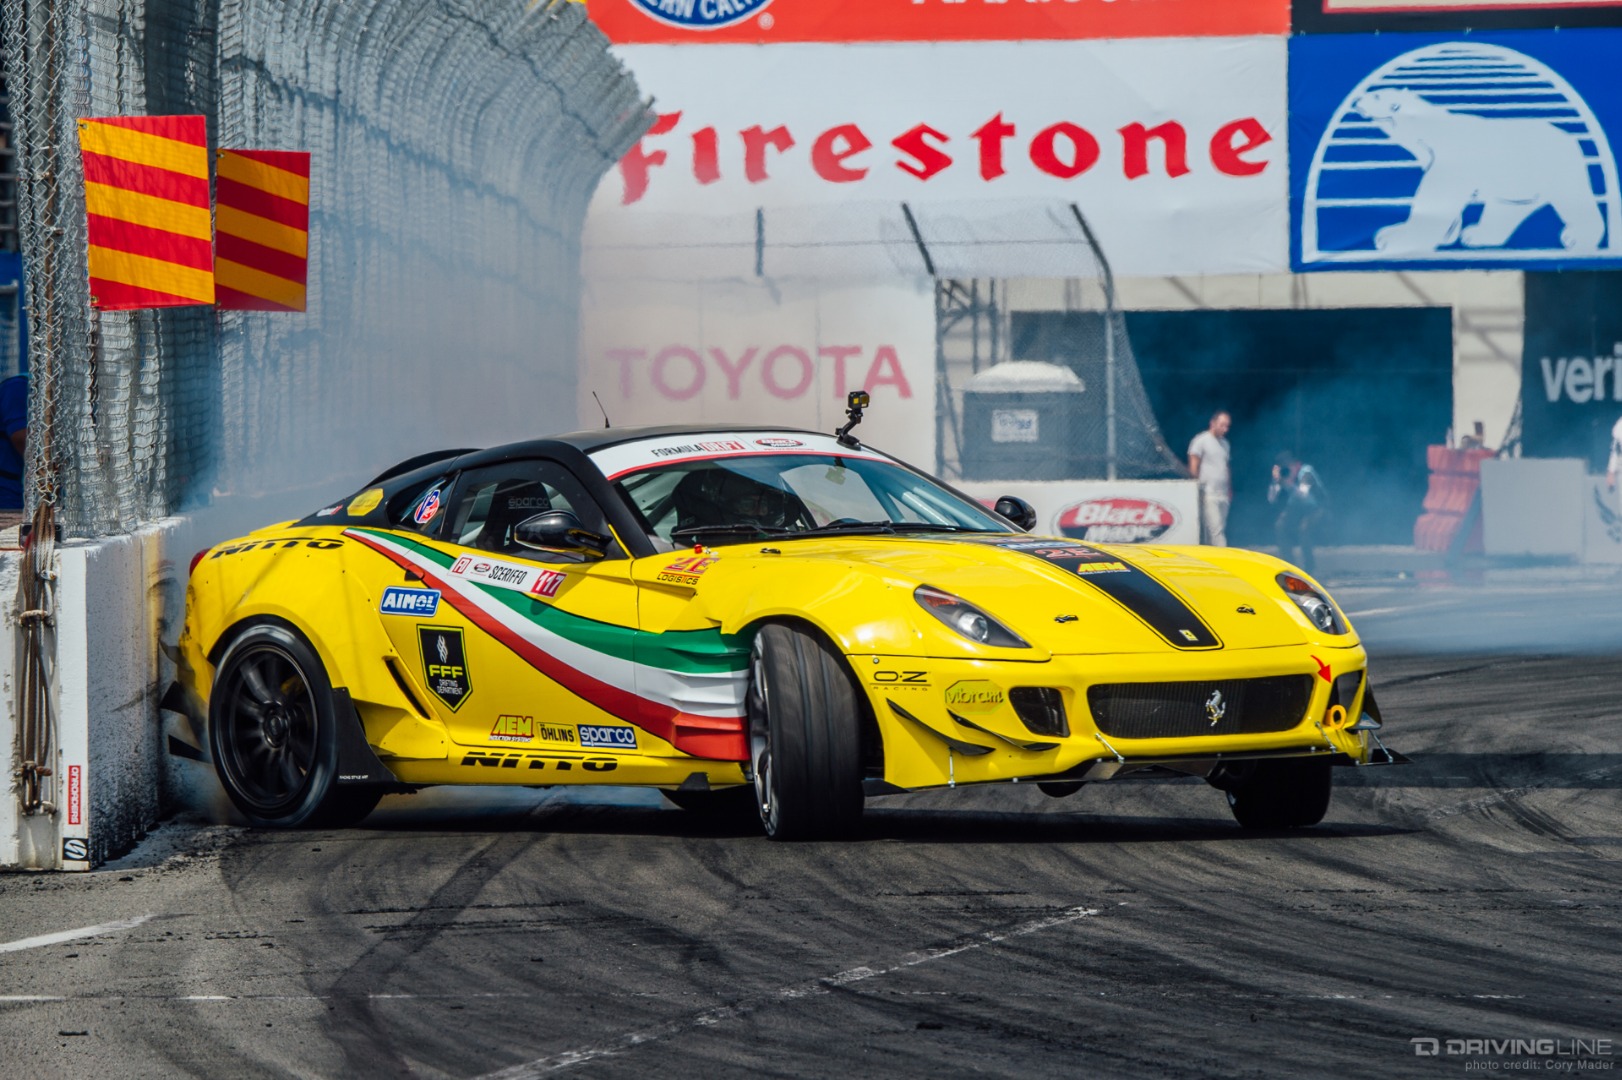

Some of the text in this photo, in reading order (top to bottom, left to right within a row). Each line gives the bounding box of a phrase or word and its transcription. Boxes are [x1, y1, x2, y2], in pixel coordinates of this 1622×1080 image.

[619, 110, 1273, 205] Firestone
[605, 344, 913, 399] TOYOTA
[651, 444, 704, 457] FORMULA
[508, 496, 549, 509] sparco
[1074, 502, 1162, 525] Black
[209, 537, 345, 560] NITTO
[1078, 562, 1127, 572] AEM
[488, 565, 528, 585] SCERIFFO
[536, 572, 566, 594] 117
[656, 574, 699, 586] LOGISTICS
[382, 592, 436, 610] AIMOL
[429, 665, 463, 678] FFF
[490, 715, 534, 737] AEM
[540, 724, 575, 743] ÖHLINS
[580, 726, 635, 746] sparco
[460, 751, 618, 771] NITTO
